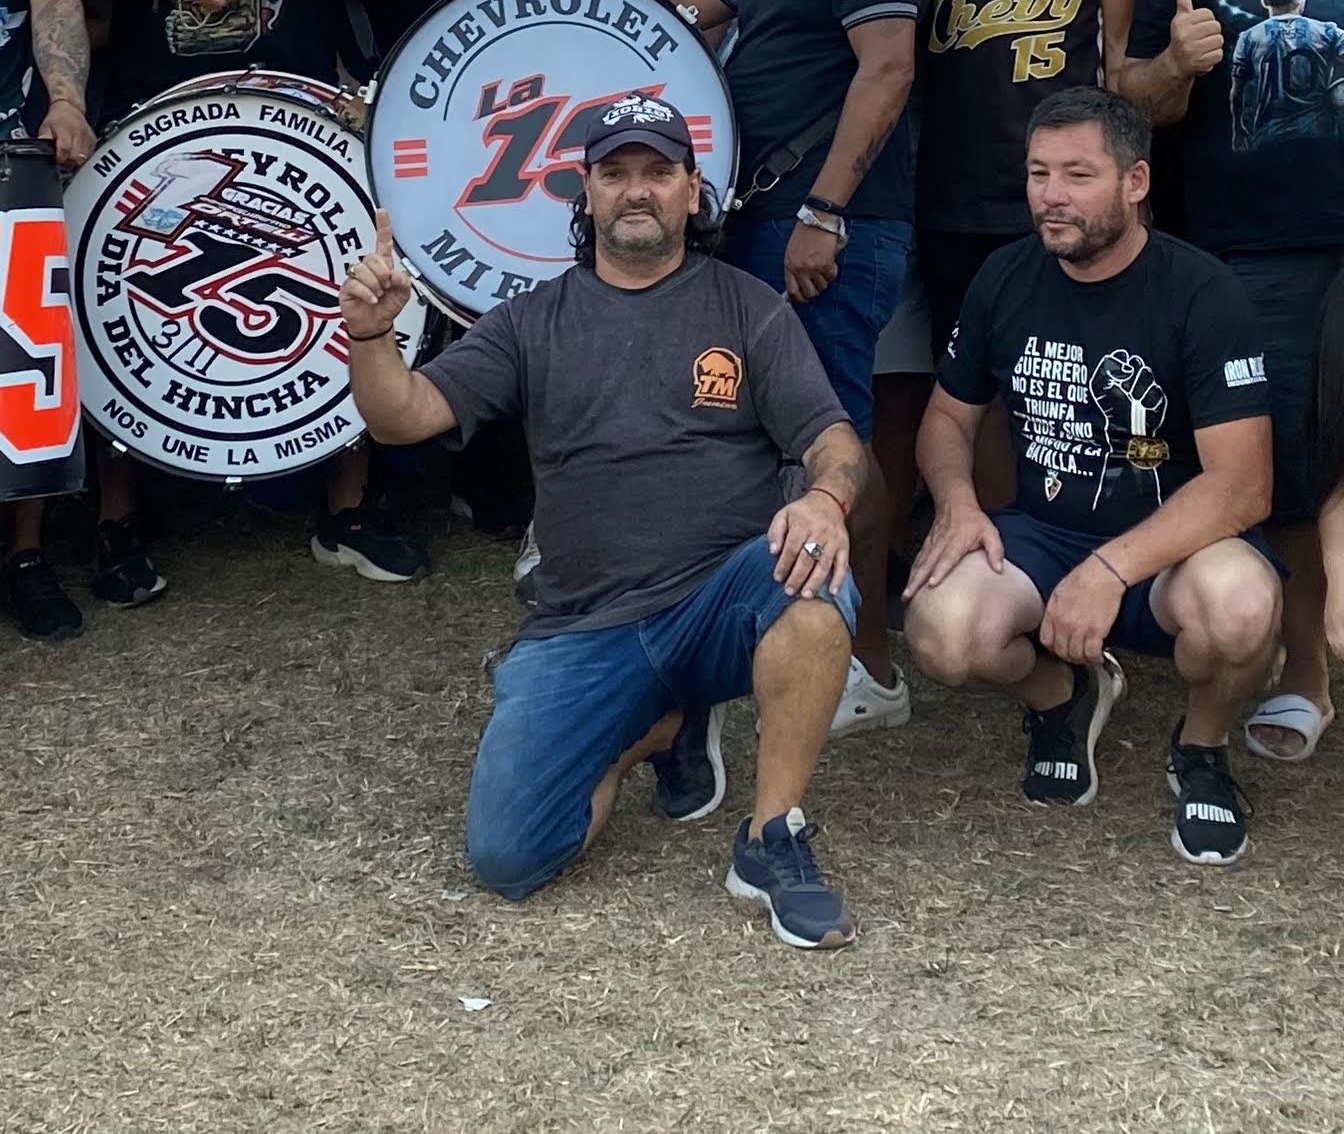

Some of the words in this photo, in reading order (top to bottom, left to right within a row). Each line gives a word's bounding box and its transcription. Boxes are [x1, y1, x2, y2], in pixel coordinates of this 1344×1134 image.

[1010, 31, 1067, 83] 15
[93, 149, 123, 179] MI
[128, 102, 241, 148] SAGRADA
[97, 233, 129, 307] DIA
[123, 229, 346, 358] 15
[102, 315, 156, 389] DEL
[1014, 356, 1088, 385] GUERRERO
[1024, 336, 1040, 357] EL
[1044, 341, 1084, 363] MEJOR
[161, 368, 330, 421] HINCHA
[700, 374, 735, 397] TM
[1011, 376, 1027, 394] NO
[1029, 379, 1044, 397] ES
[1047, 382, 1063, 400] EL
[1067, 385, 1089, 404] QUE
[1024, 397, 1075, 421] TRIUNFA
[103, 398, 149, 439] NOS
[162, 435, 210, 463] UNE
[227, 449, 259, 466] LA
[274, 413, 352, 460] MISMA
[1186, 803, 1236, 824] PUMA
